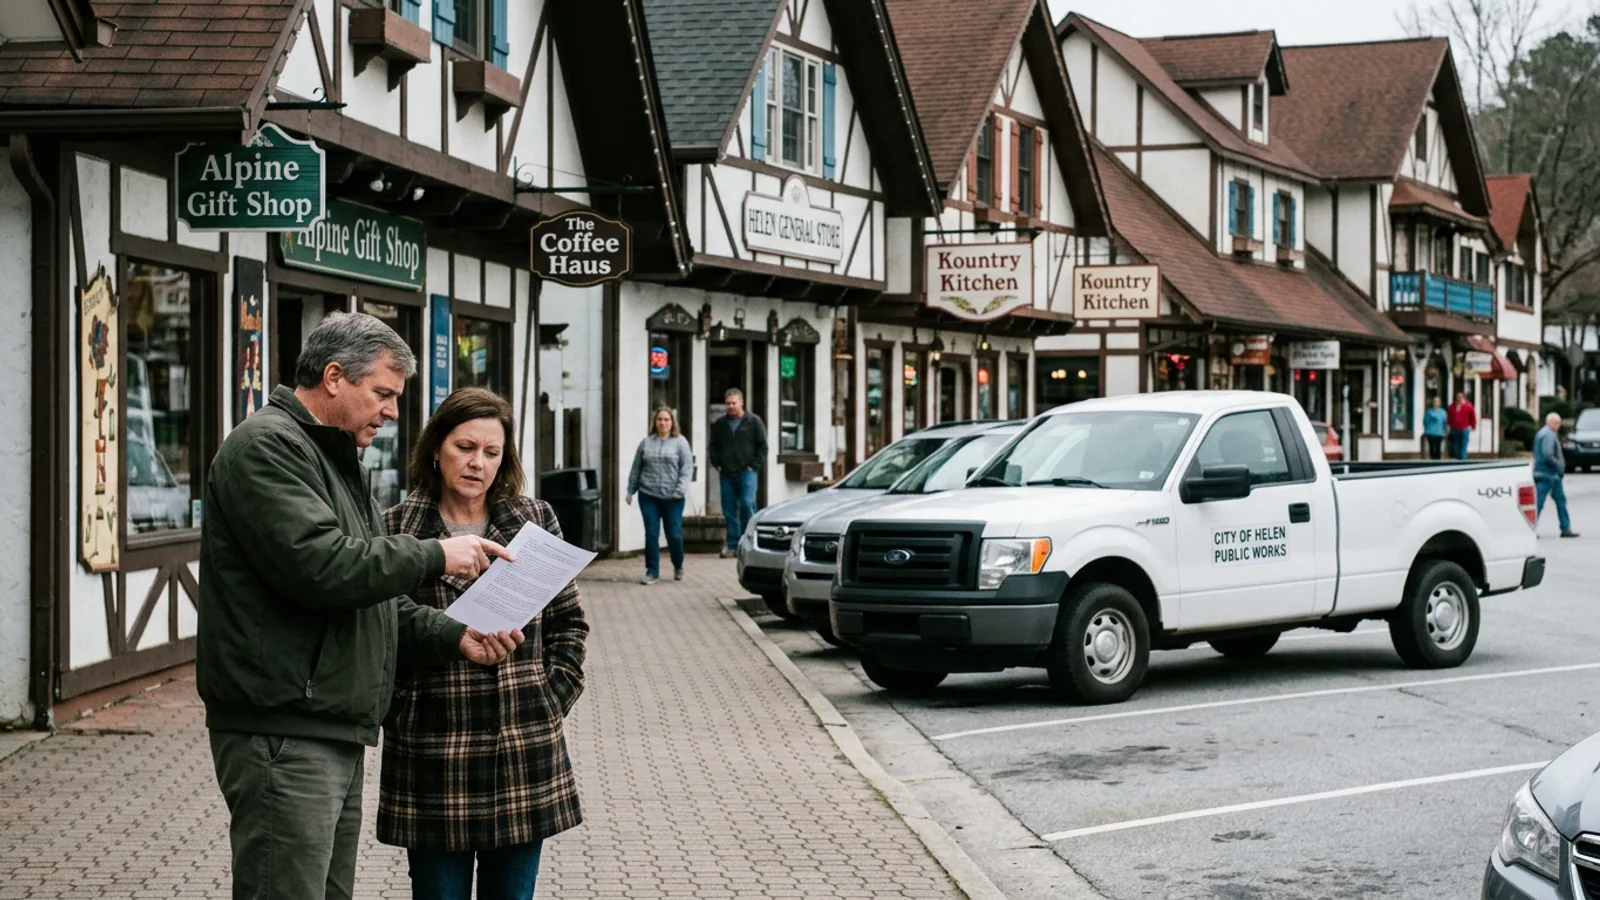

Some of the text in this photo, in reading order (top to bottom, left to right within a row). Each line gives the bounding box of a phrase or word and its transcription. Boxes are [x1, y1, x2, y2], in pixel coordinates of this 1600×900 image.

[199, 152, 300, 189] Alpine
[187, 190, 312, 223] Gift Shop
[565, 217, 595, 230] The
[748, 208, 841, 249] HELEN GENERAL STORE
[353, 218, 381, 263] Gift
[385, 225, 420, 280] Shop
[540, 232, 620, 253] Coffee
[548, 255, 612, 274] Haus
[938, 252, 1021, 271] Kountry
[940, 273, 1019, 292] Kitchen
[1080, 273, 1152, 292] Kountry
[1083, 294, 1149, 311] Kitchen
[1214, 526, 1286, 545] CITY OF HELEN
[1214, 544, 1287, 563] PUBLIC WORKS
